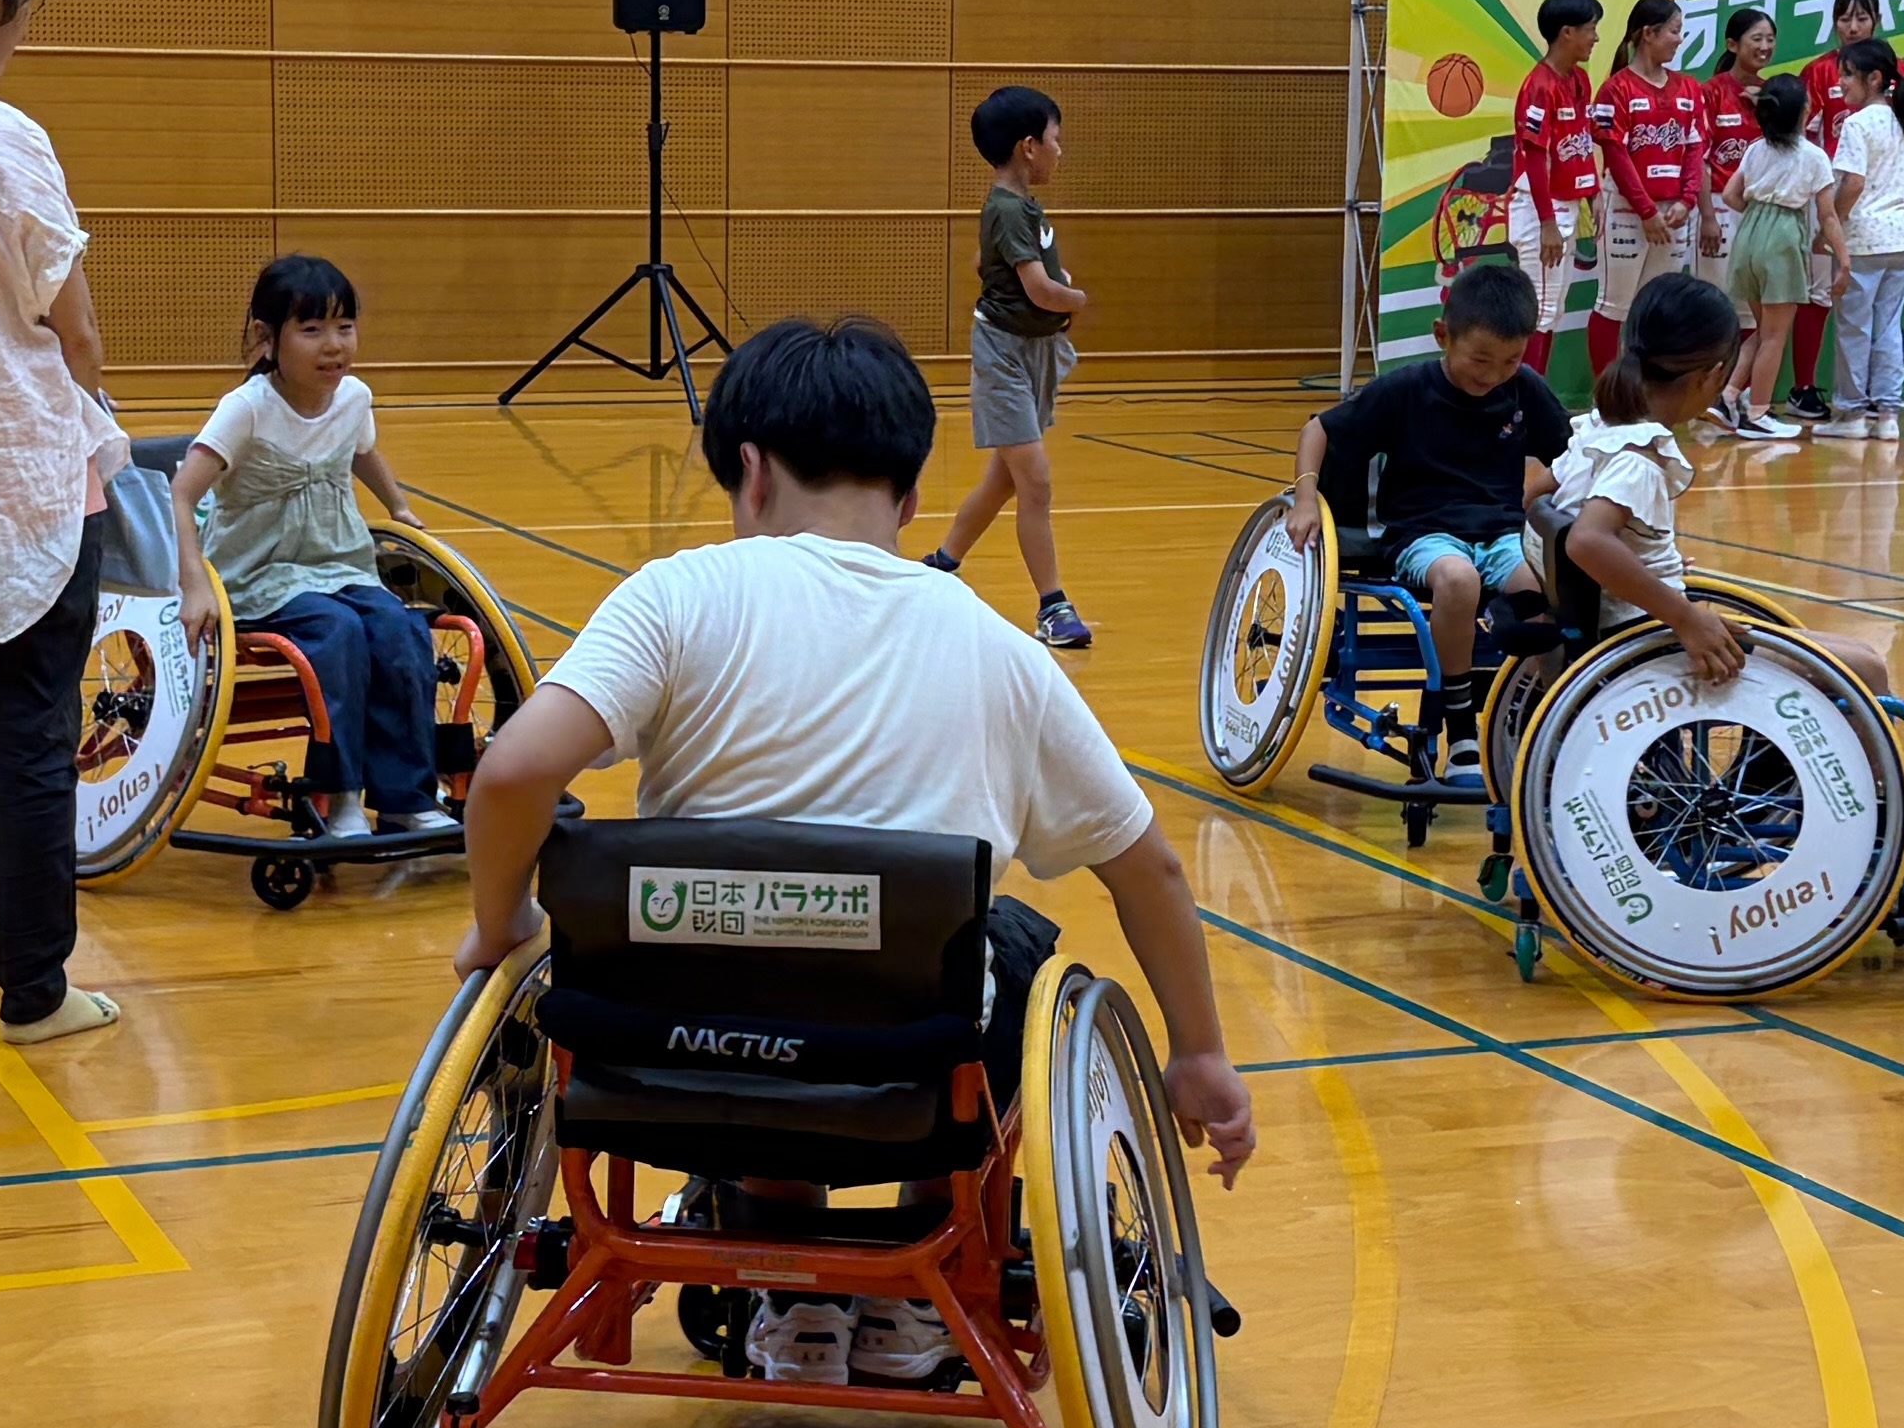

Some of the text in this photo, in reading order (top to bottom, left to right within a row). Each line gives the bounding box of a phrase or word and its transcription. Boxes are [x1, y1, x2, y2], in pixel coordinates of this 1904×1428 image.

[1595, 714, 1609, 741] i
[98, 771, 150, 822] enjoy
[1818, 752, 1865, 818] パラサポ
[1563, 796, 1610, 861] パラサポ
[693, 880, 746, 906] 日本
[754, 881, 868, 914] パラサポ
[1821, 871, 1834, 900] i
[693, 910, 744, 935] 財団
[1730, 881, 1814, 939] enjoy
[667, 1025, 805, 1063] NACTUS
